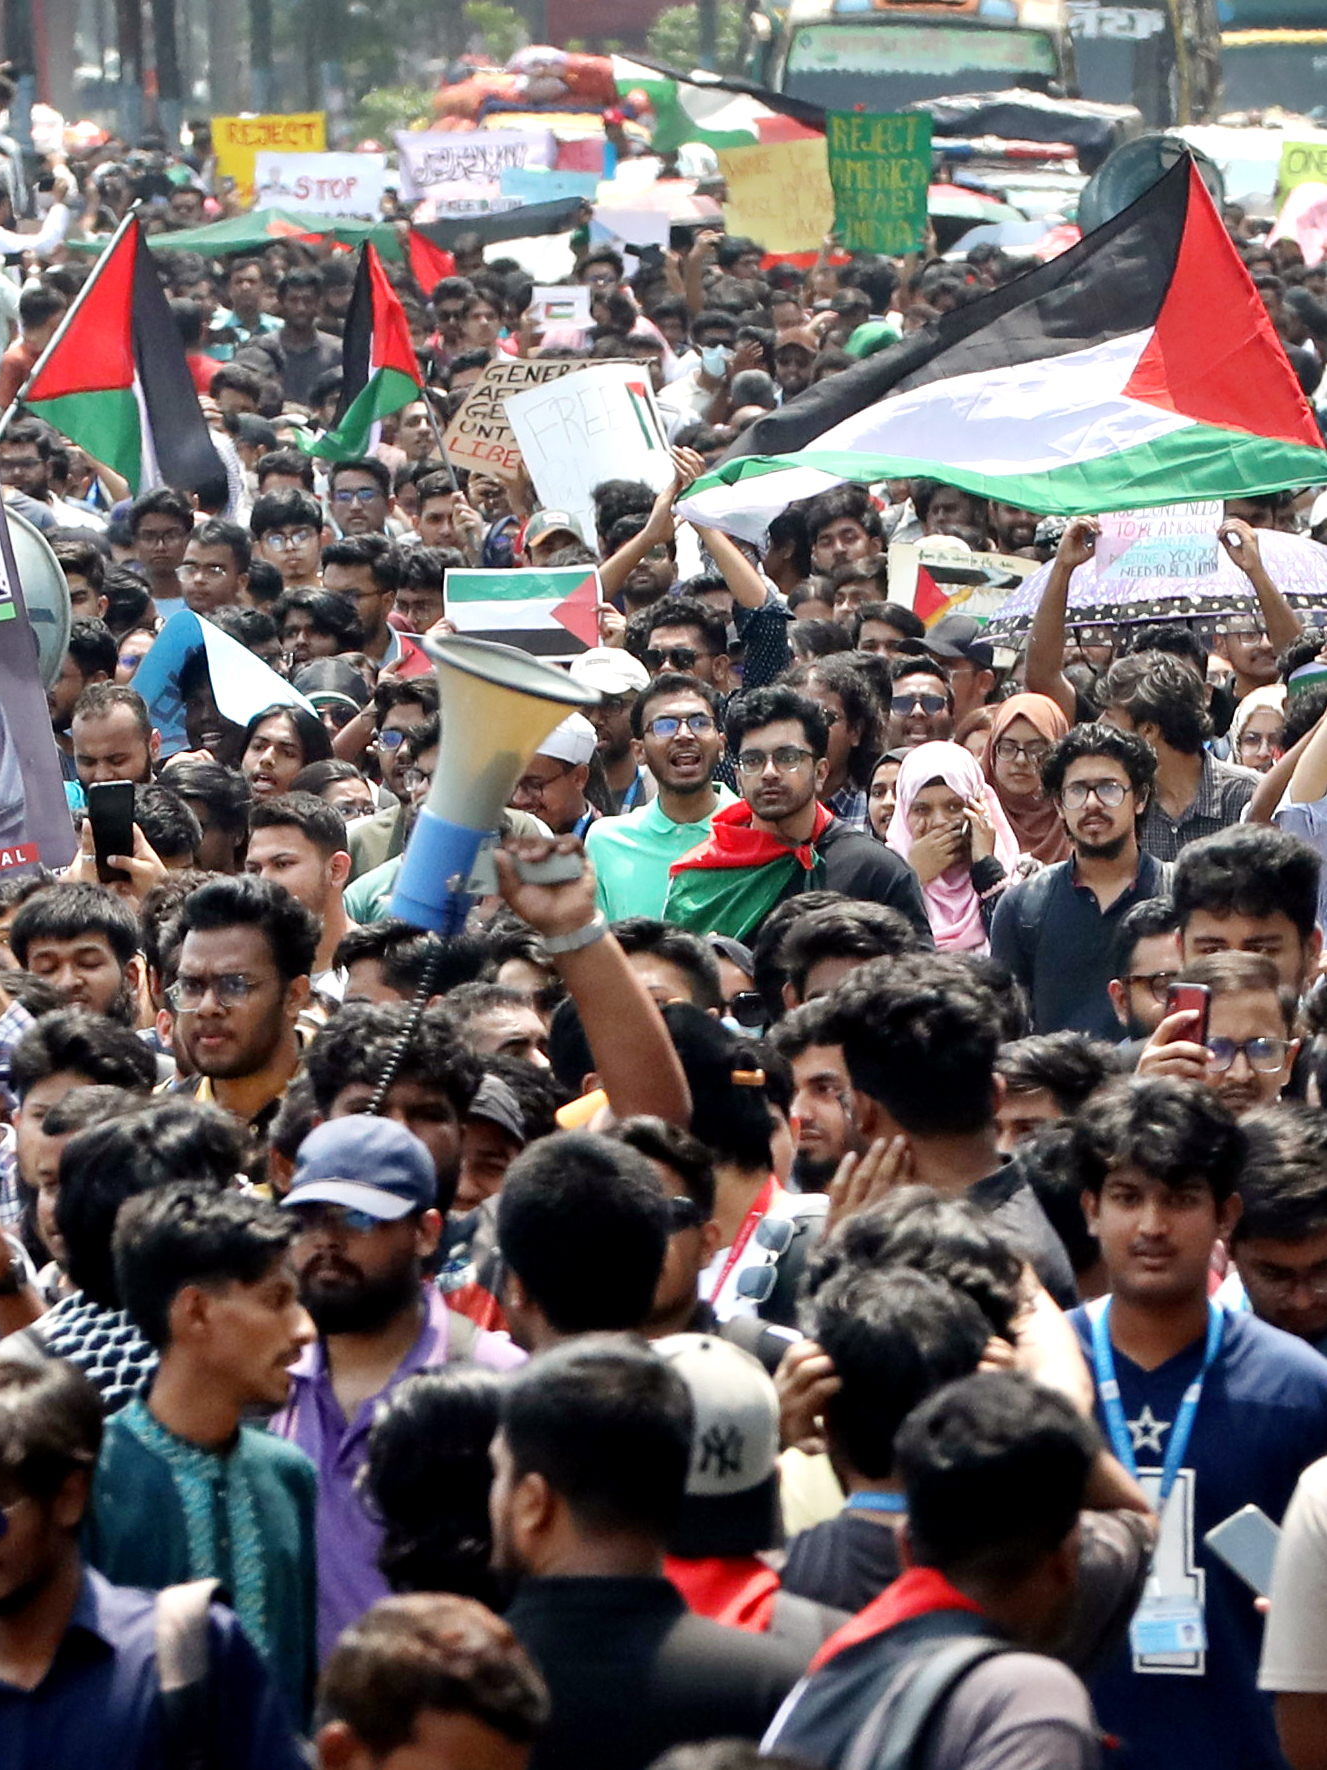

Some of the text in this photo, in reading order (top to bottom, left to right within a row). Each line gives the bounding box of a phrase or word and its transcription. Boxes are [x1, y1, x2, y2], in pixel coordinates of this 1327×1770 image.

[228, 122, 315, 146] REJECT
[832, 115, 919, 153] REJECT
[295, 175, 358, 200] STOP
[524, 386, 622, 462] FREE
[1115, 521, 1135, 538] TO
[1138, 521, 1153, 539] BE
[1158, 521, 1168, 537] A
[1169, 548, 1194, 562] YOU
[1120, 564, 1152, 578] NEED
[1153, 564, 1166, 578] TO
[1168, 562, 1181, 577] BE
[1185, 562, 1192, 577] A
